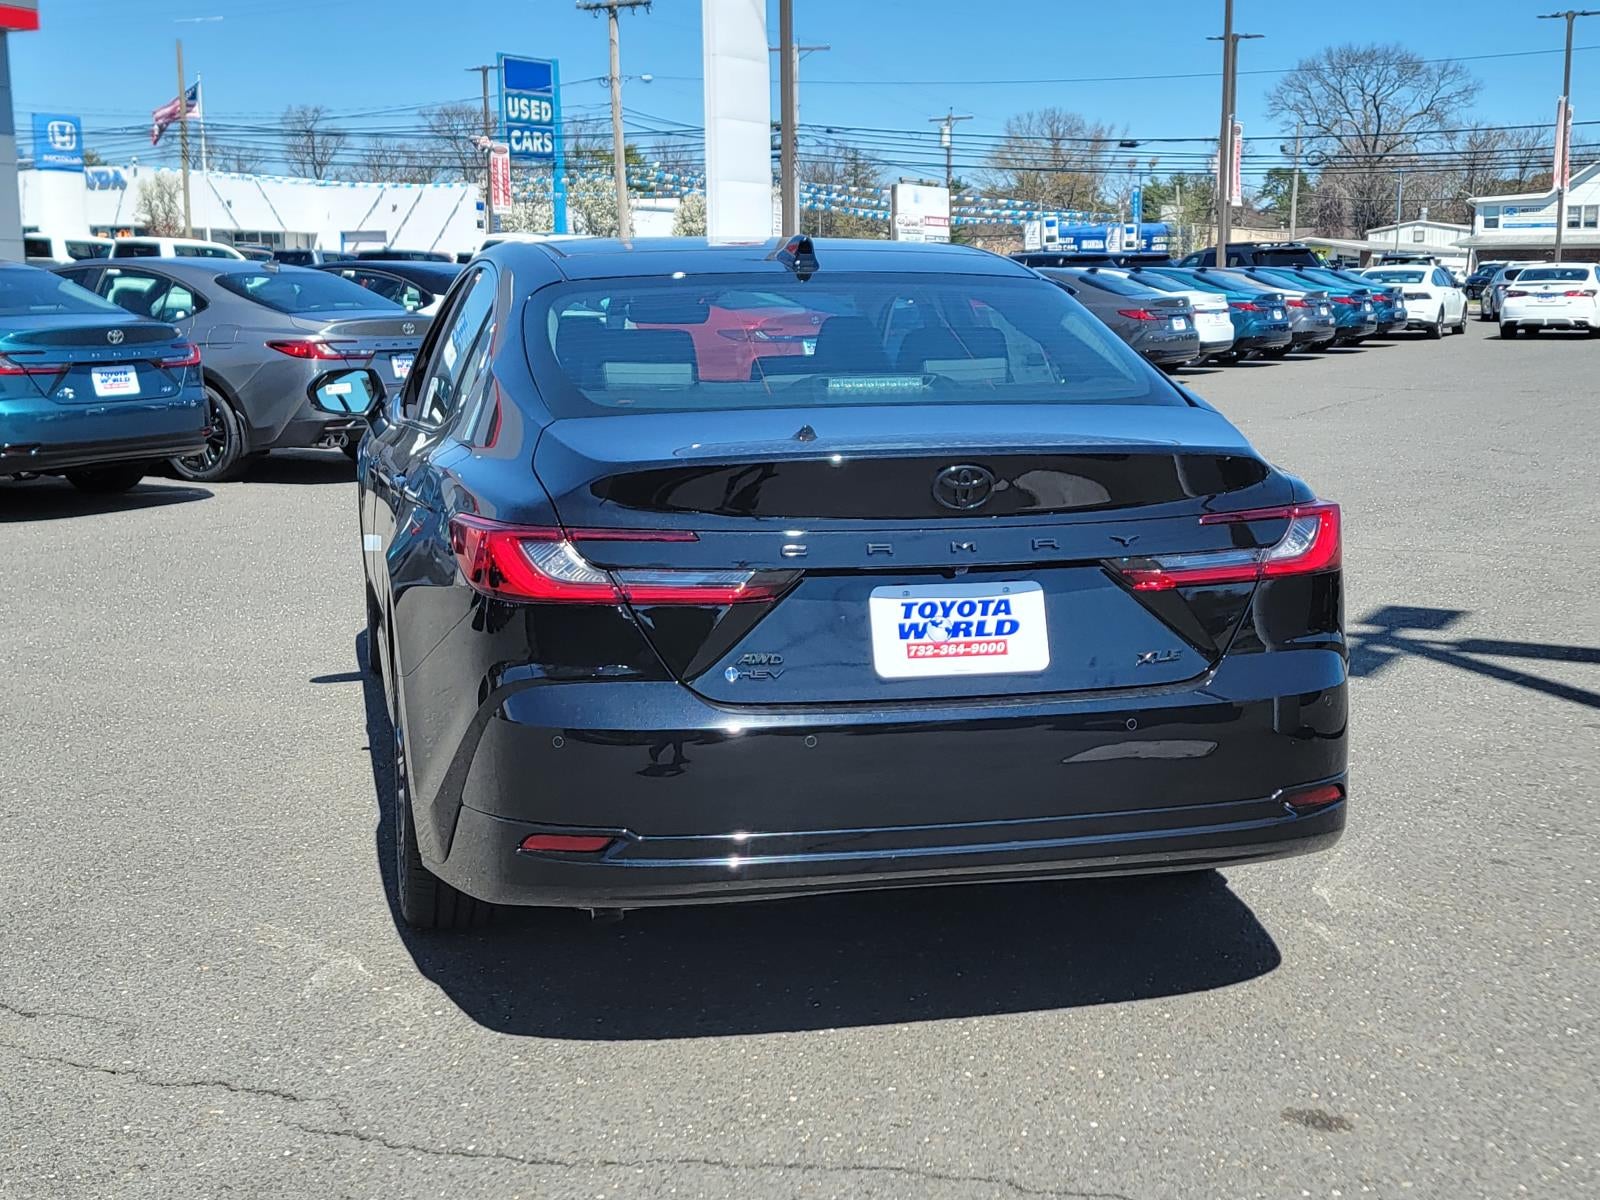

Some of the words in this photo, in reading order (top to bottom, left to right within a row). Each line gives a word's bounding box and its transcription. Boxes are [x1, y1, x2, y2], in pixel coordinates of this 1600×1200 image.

[507, 97, 552, 122] USED
[511, 129, 553, 153] CARS
[780, 535, 1140, 557] CAMRY
[901, 599, 1012, 619] TOYOTA
[738, 653, 785, 665] AWD
[909, 642, 1006, 656] 732-364-9000
[1136, 650, 1183, 666] XLE
